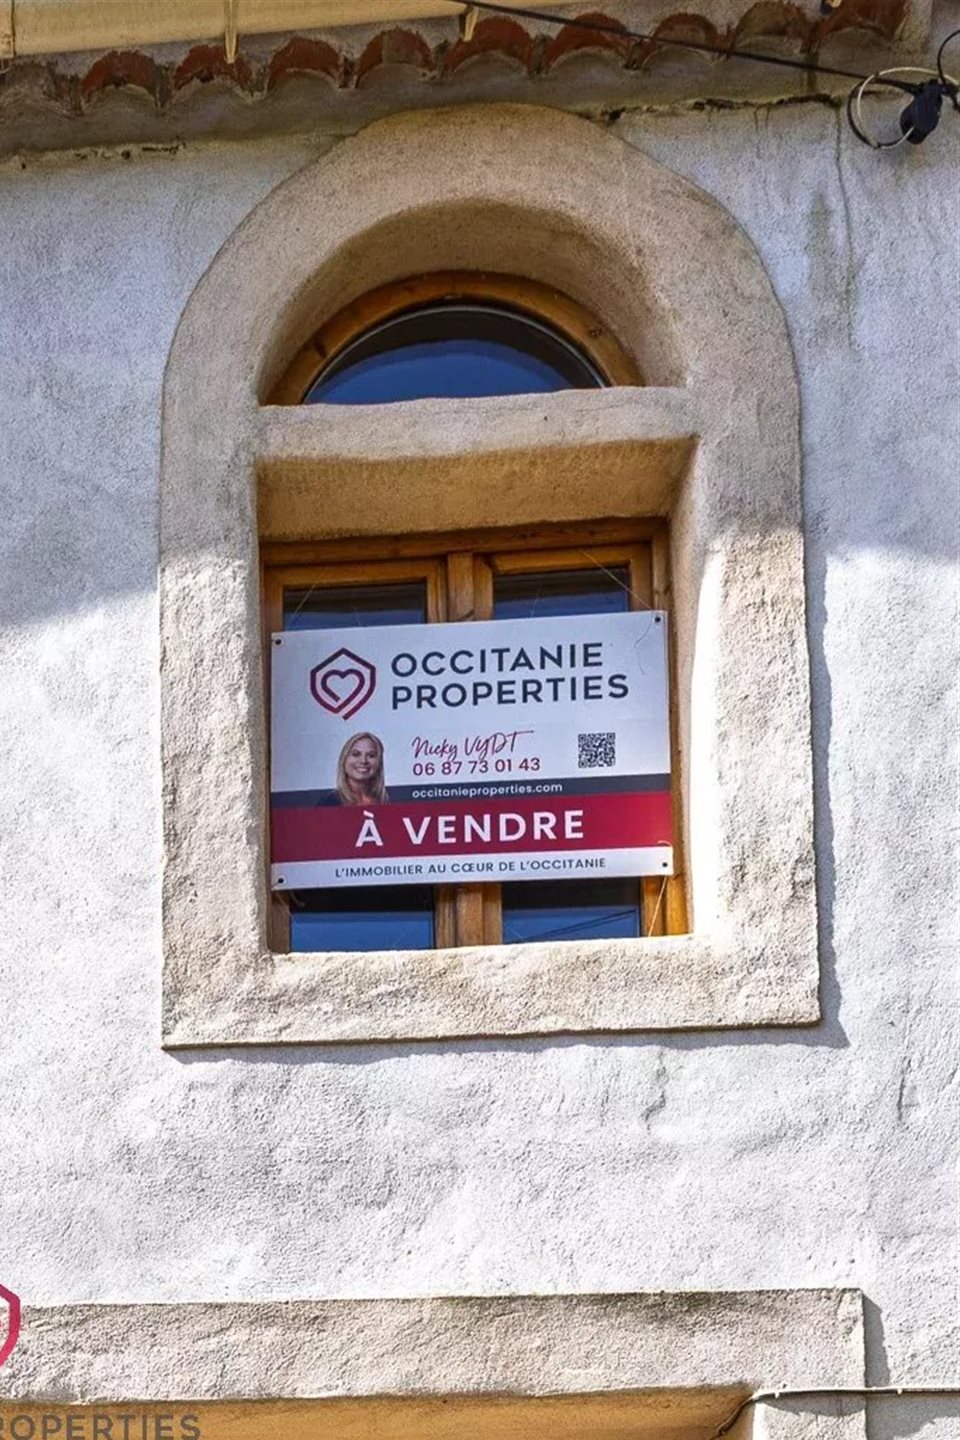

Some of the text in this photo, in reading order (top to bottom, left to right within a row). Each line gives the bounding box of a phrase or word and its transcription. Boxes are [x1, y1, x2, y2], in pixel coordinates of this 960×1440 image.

[390, 643, 604, 678] OCCITANIE
[391, 674, 630, 710] PROPERTIES
[411, 736, 458, 763] Nicky
[412, 757, 541, 776] 06 87 73 01 43
[412, 783, 563, 798] occitanieproperties.com
[355, 810, 585, 848] À VENDRE
[335, 858, 606, 878] L'IMMOBILIER AU CŒUR DE L'OCCITANIE
